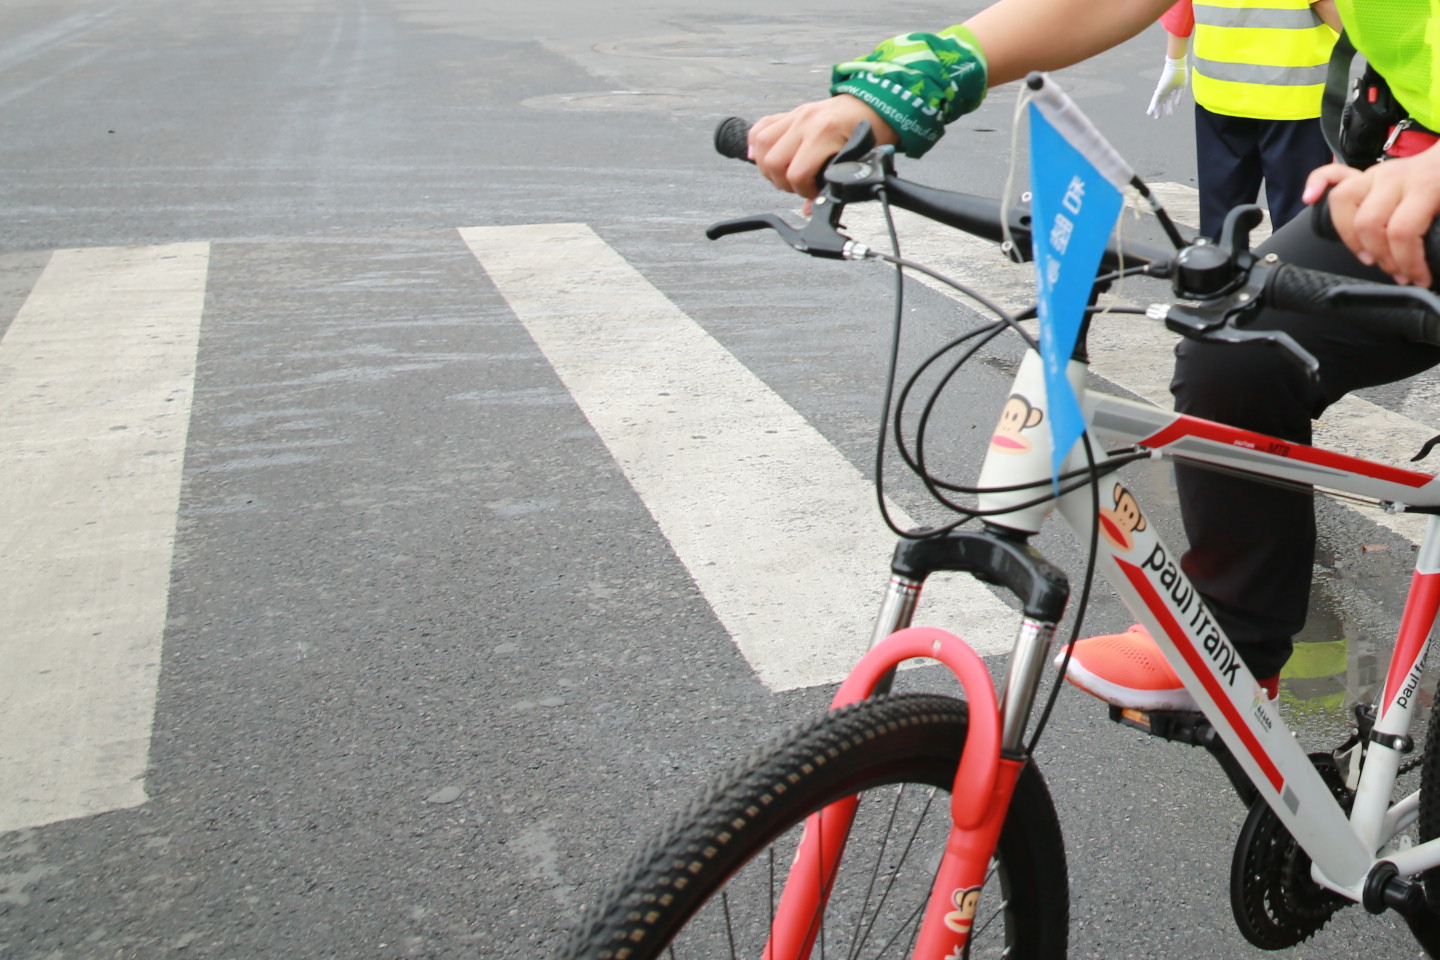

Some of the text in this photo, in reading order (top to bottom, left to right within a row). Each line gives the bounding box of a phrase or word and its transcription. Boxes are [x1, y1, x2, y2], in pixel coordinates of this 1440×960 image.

[1141, 542, 1241, 687] paul frank
[1396, 673, 1419, 709] paul
